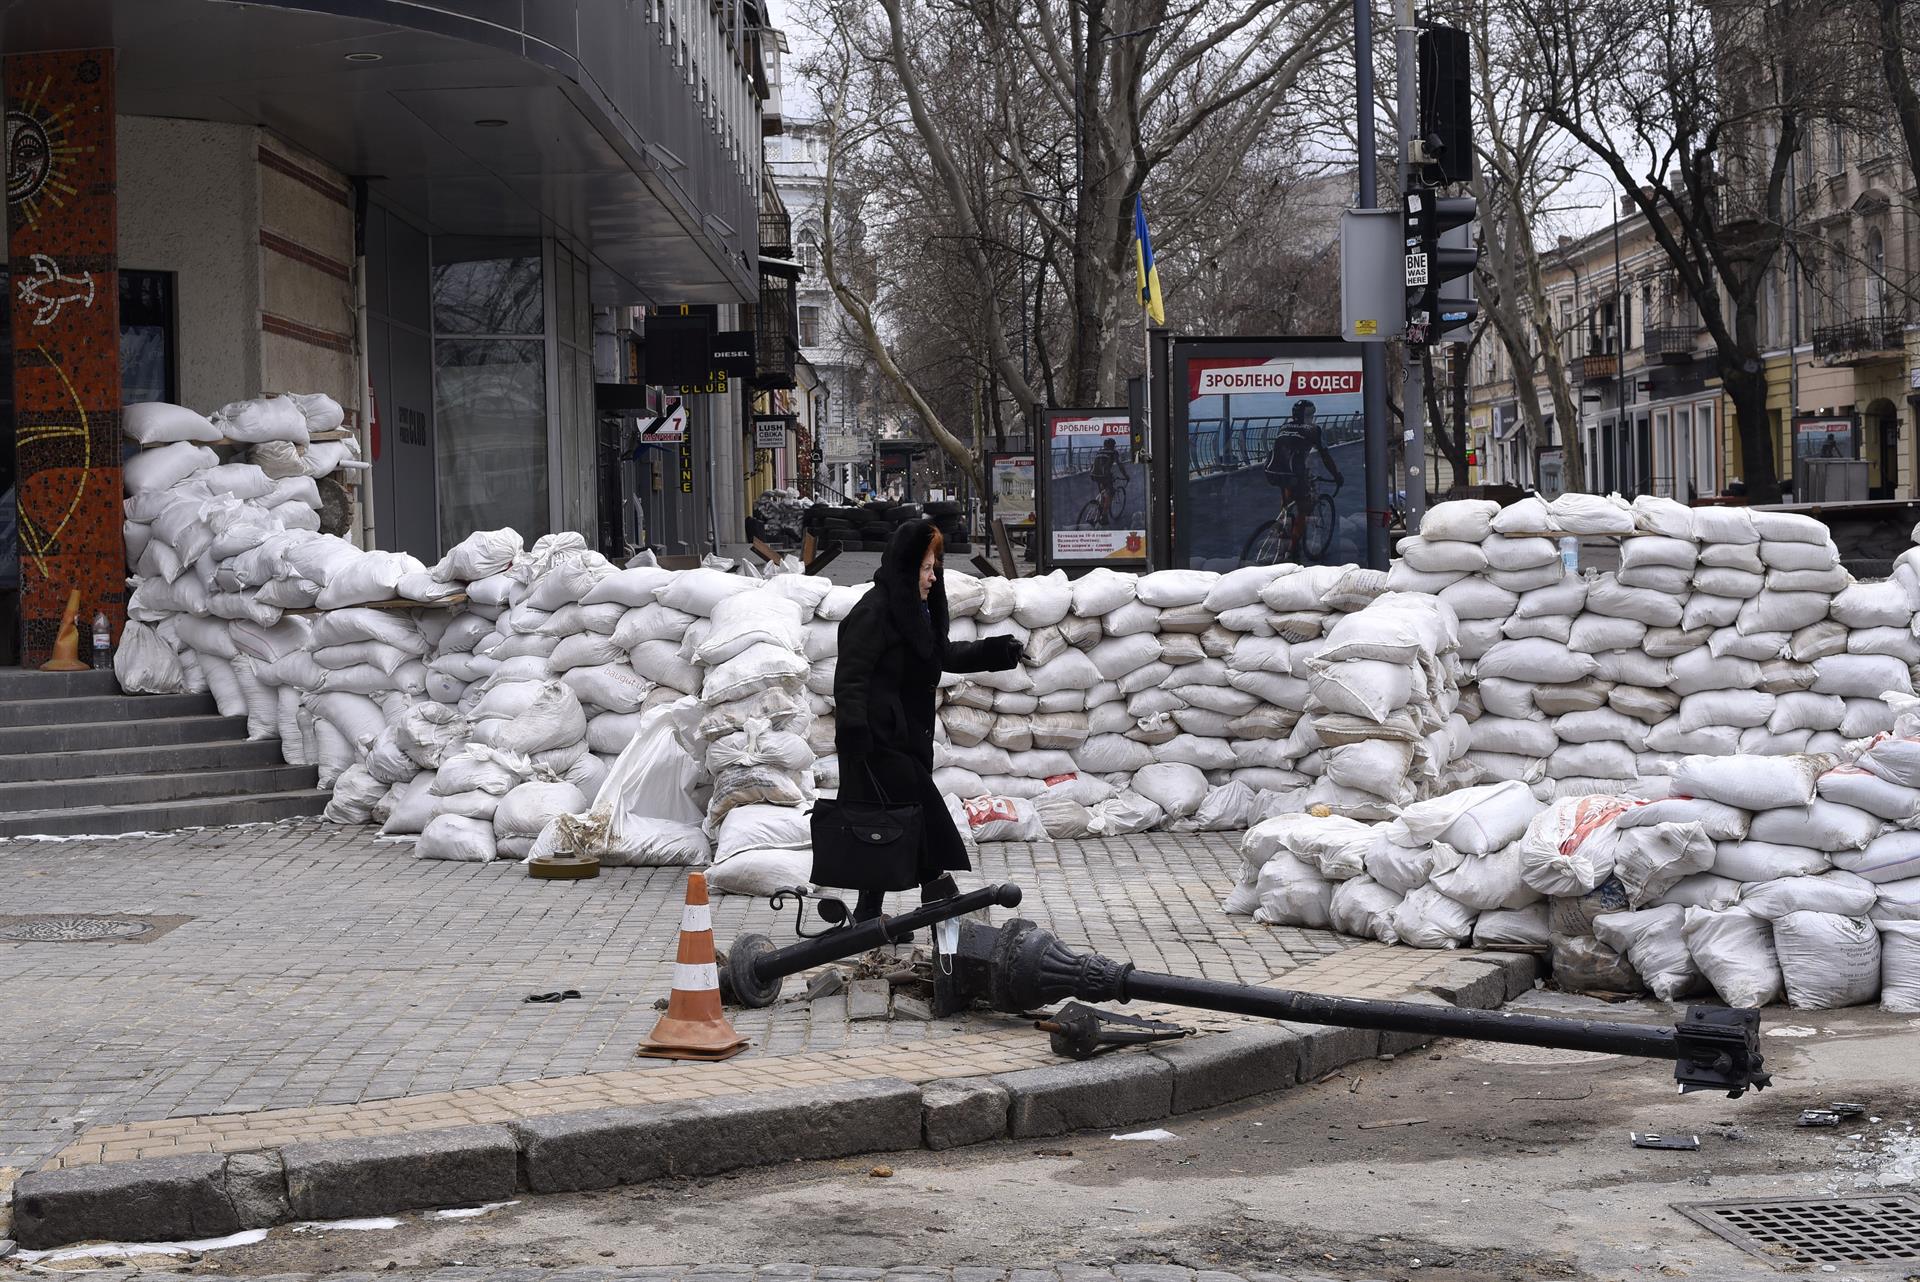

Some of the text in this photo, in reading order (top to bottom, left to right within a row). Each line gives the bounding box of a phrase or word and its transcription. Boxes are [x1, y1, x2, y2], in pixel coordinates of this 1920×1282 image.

[1407, 254, 1426, 268] BNE
[1407, 268, 1426, 276] WAS
[1407, 276, 1427, 284] HERE
[1205, 373, 1354, 391] ЗРОБЛЕНО В ОДЕСІ
[681, 383, 726, 394] CLUB
[672, 417, 682, 431] 7
[758, 424, 783, 432] LUSH
[1058, 424, 1130, 434] ЗРОБЛЕНО В ОДЕ
